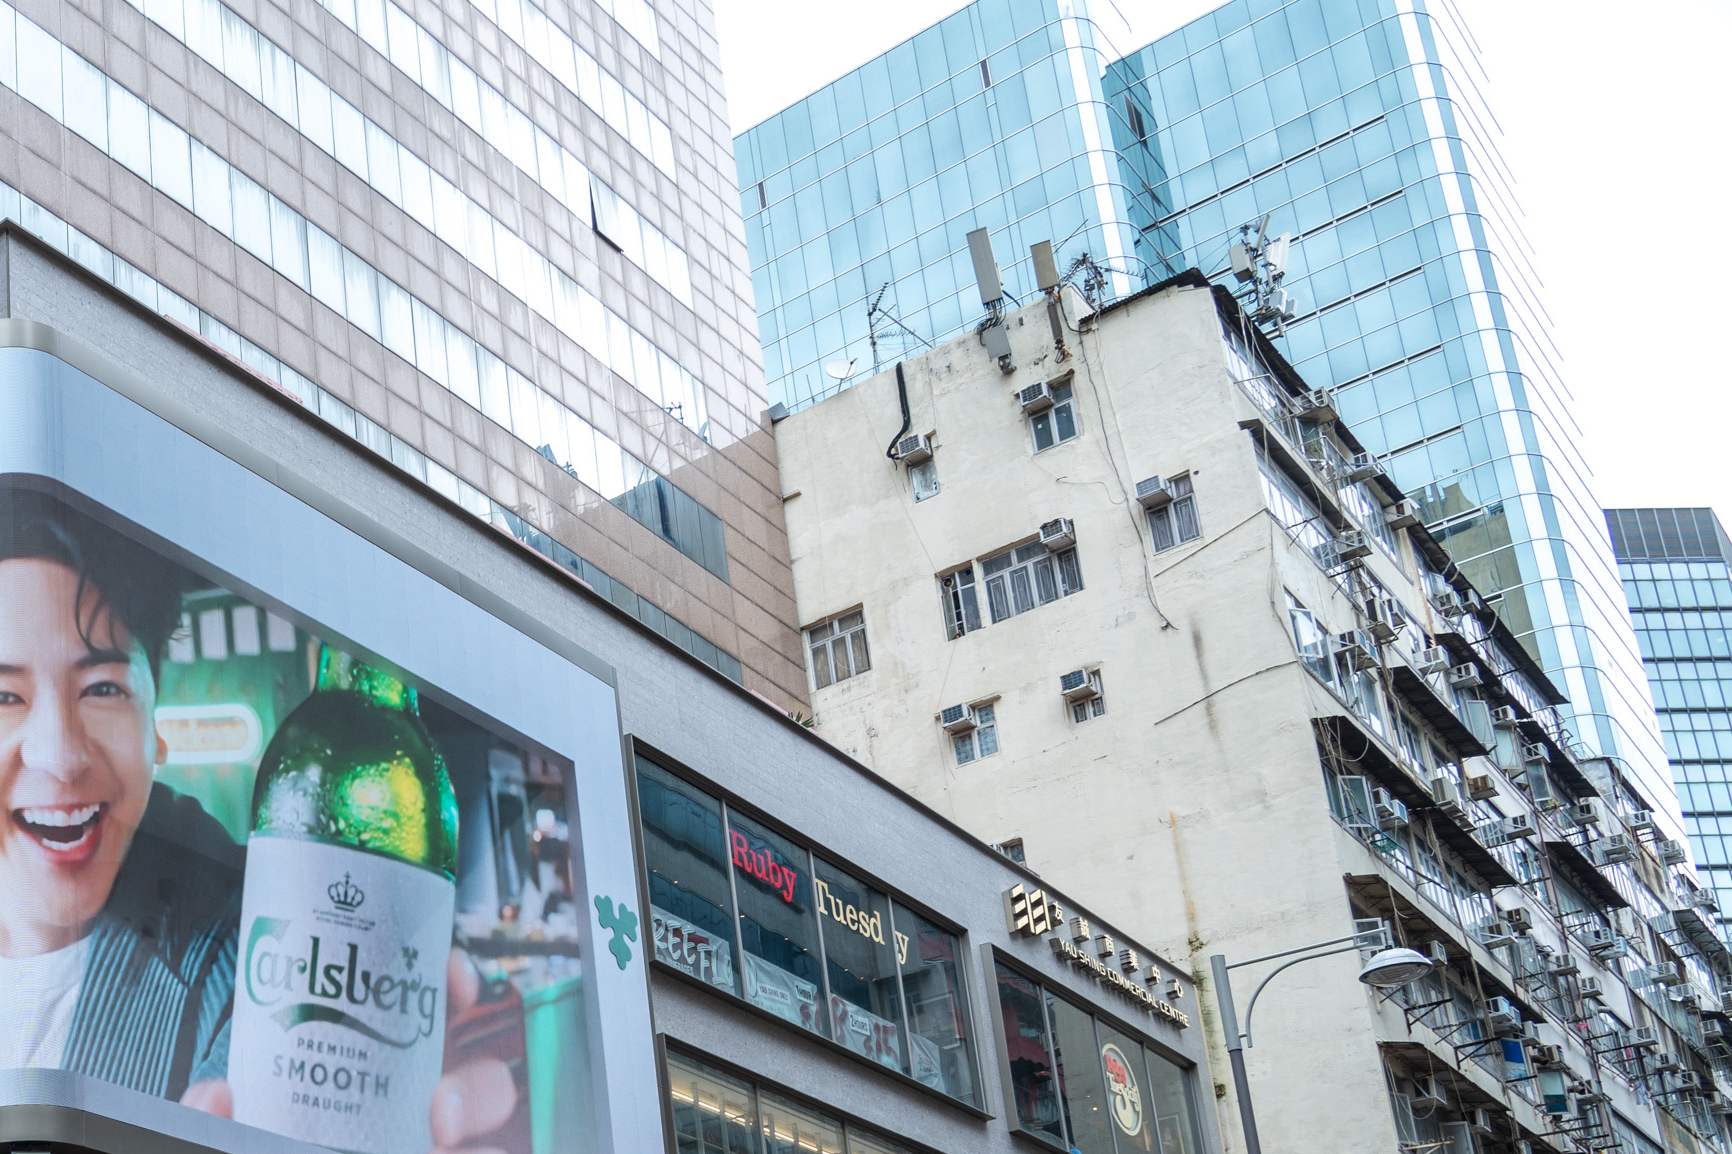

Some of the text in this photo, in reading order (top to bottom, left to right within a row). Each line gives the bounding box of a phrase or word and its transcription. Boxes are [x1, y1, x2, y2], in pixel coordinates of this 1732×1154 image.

[728, 829, 796, 902] Ruby
[814, 878, 909, 964] Tuesdy
[245, 916, 437, 1037] Carlsberg
[1060, 937, 1189, 1028] YAU SHING COMMERCIAL CENTRE
[273, 1055, 390, 1098] SMOOTH
[297, 1037, 368, 1061] PREMIUM
[292, 1092, 363, 1116] DRAUGHT
